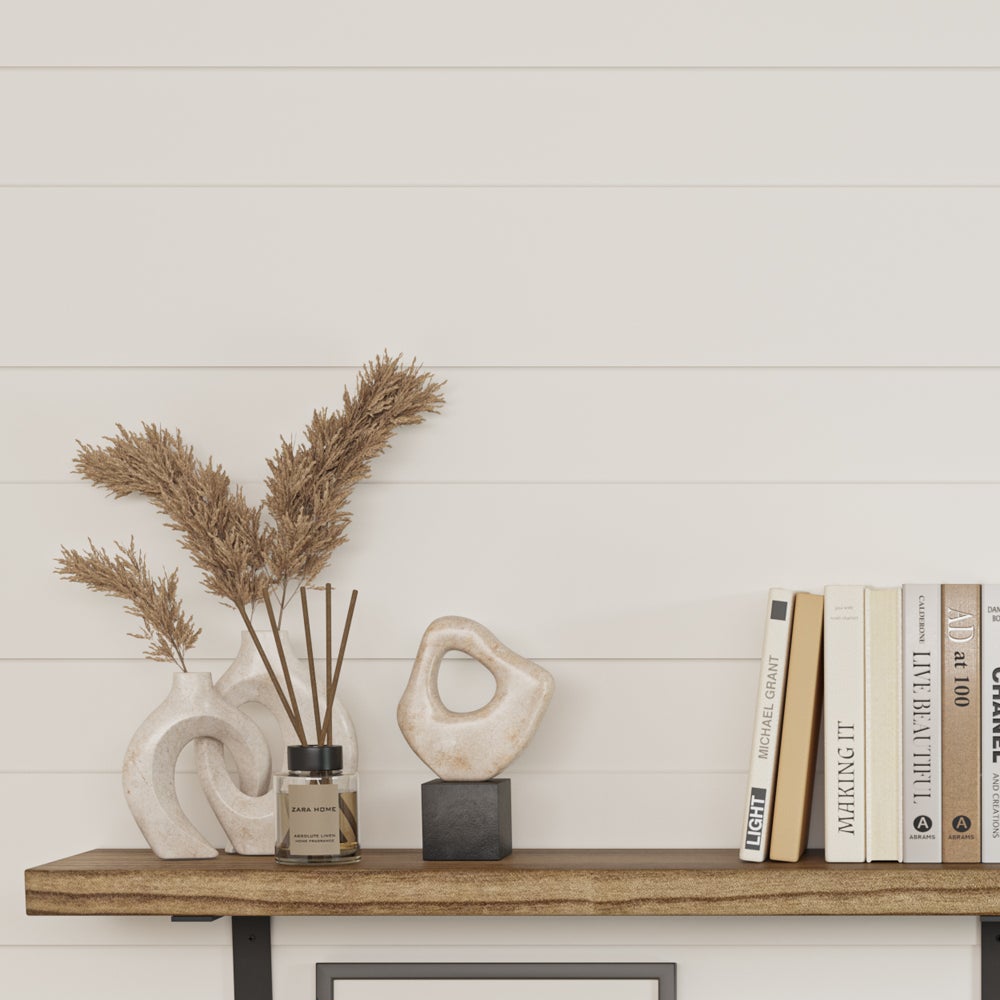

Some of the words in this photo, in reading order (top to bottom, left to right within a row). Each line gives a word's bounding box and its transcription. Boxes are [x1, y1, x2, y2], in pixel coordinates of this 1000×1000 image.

[947, 607, 976, 644] AD
[764, 654, 779, 700] GRANT
[912, 651, 931, 694] LIVE
[953, 651, 968, 669] at
[953, 676, 970, 708] 100
[757, 703, 775, 760] MICHAEL
[837, 720, 855, 742] IT
[837, 748, 855, 836] MAKING
[992, 773, 1000, 791] AND
[745, 795, 765, 846] LIGHT
[992, 793, 1000, 839] CREATIONS
